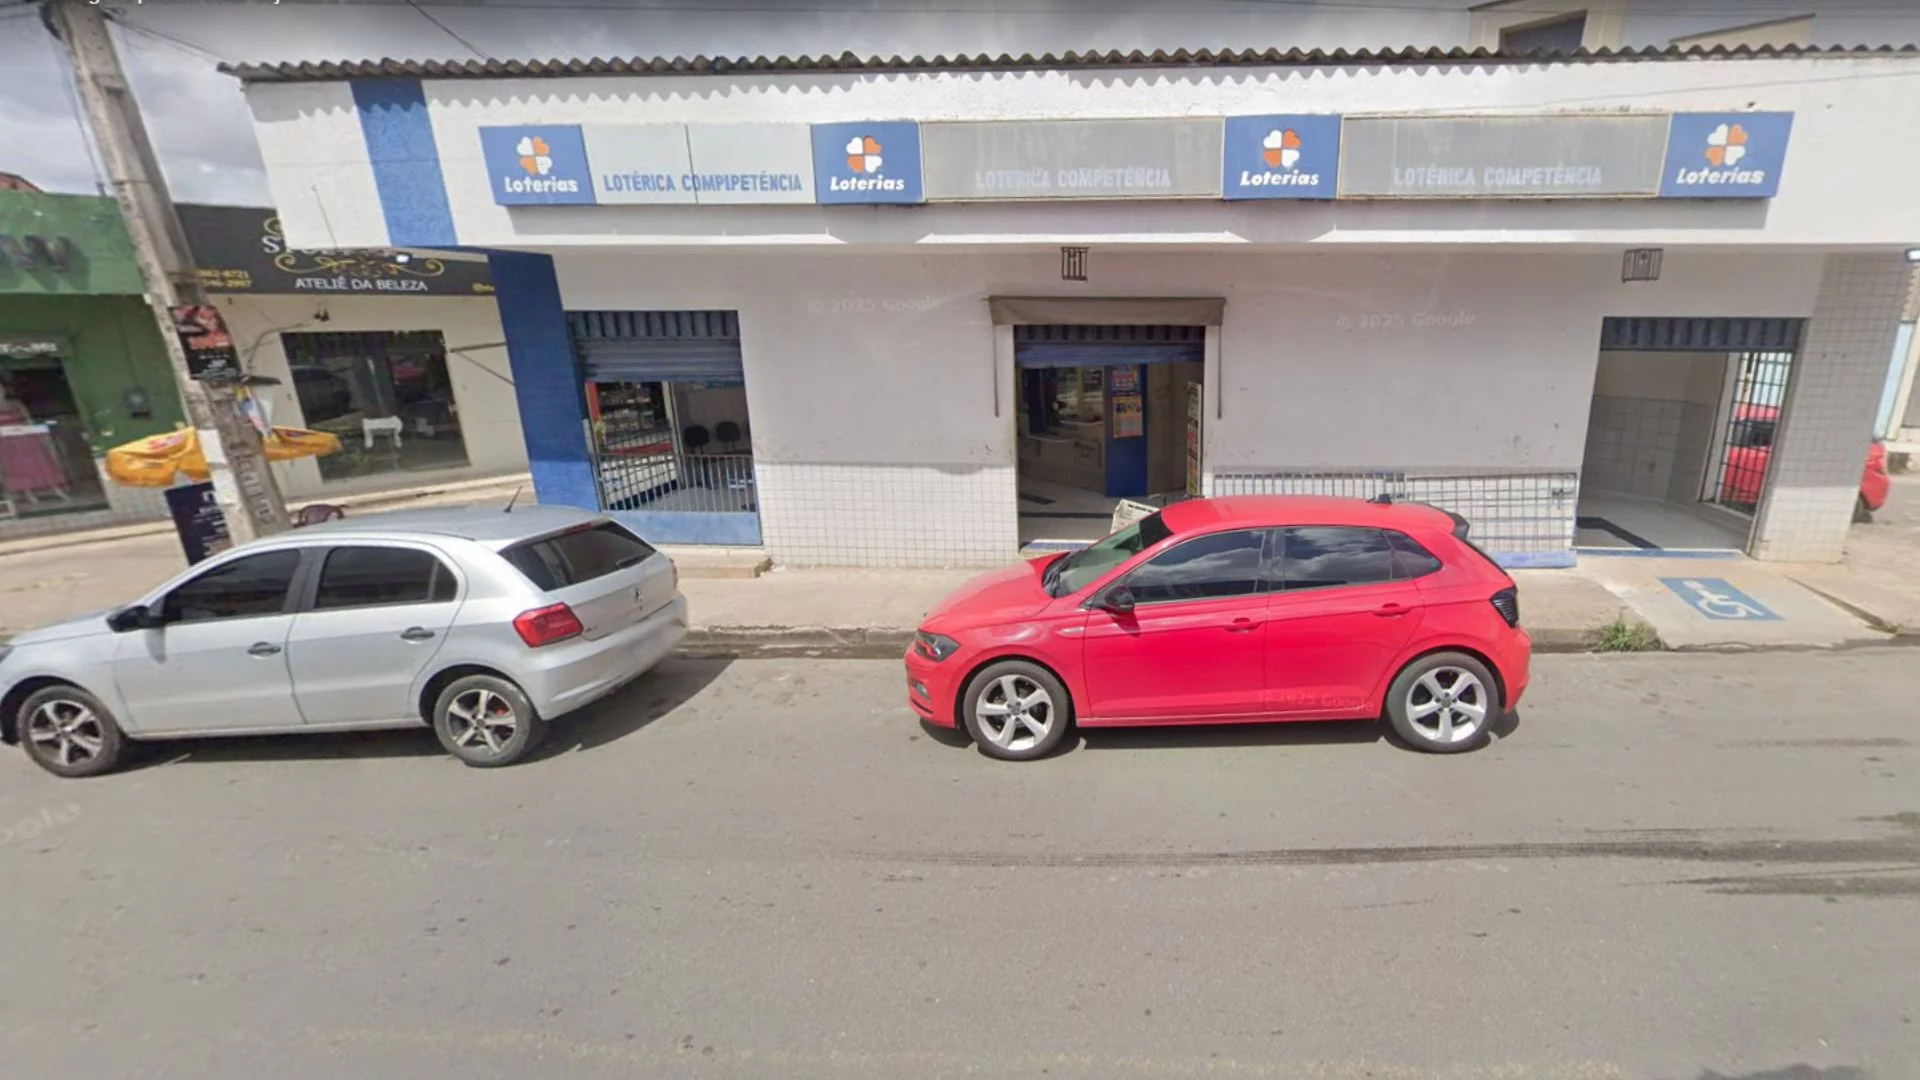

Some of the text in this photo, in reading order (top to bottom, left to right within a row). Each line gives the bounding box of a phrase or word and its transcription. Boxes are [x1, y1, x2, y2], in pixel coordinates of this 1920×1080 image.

[504, 176, 579, 193] Loterias
[603, 170, 676, 192] LOTÉRICA
[830, 175, 905, 192] Loterias
[1240, 170, 1319, 187] Loterias
[1676, 167, 1765, 185] Loterias
[352, 279, 370, 290] DA
[376, 279, 428, 291] BELEZA
